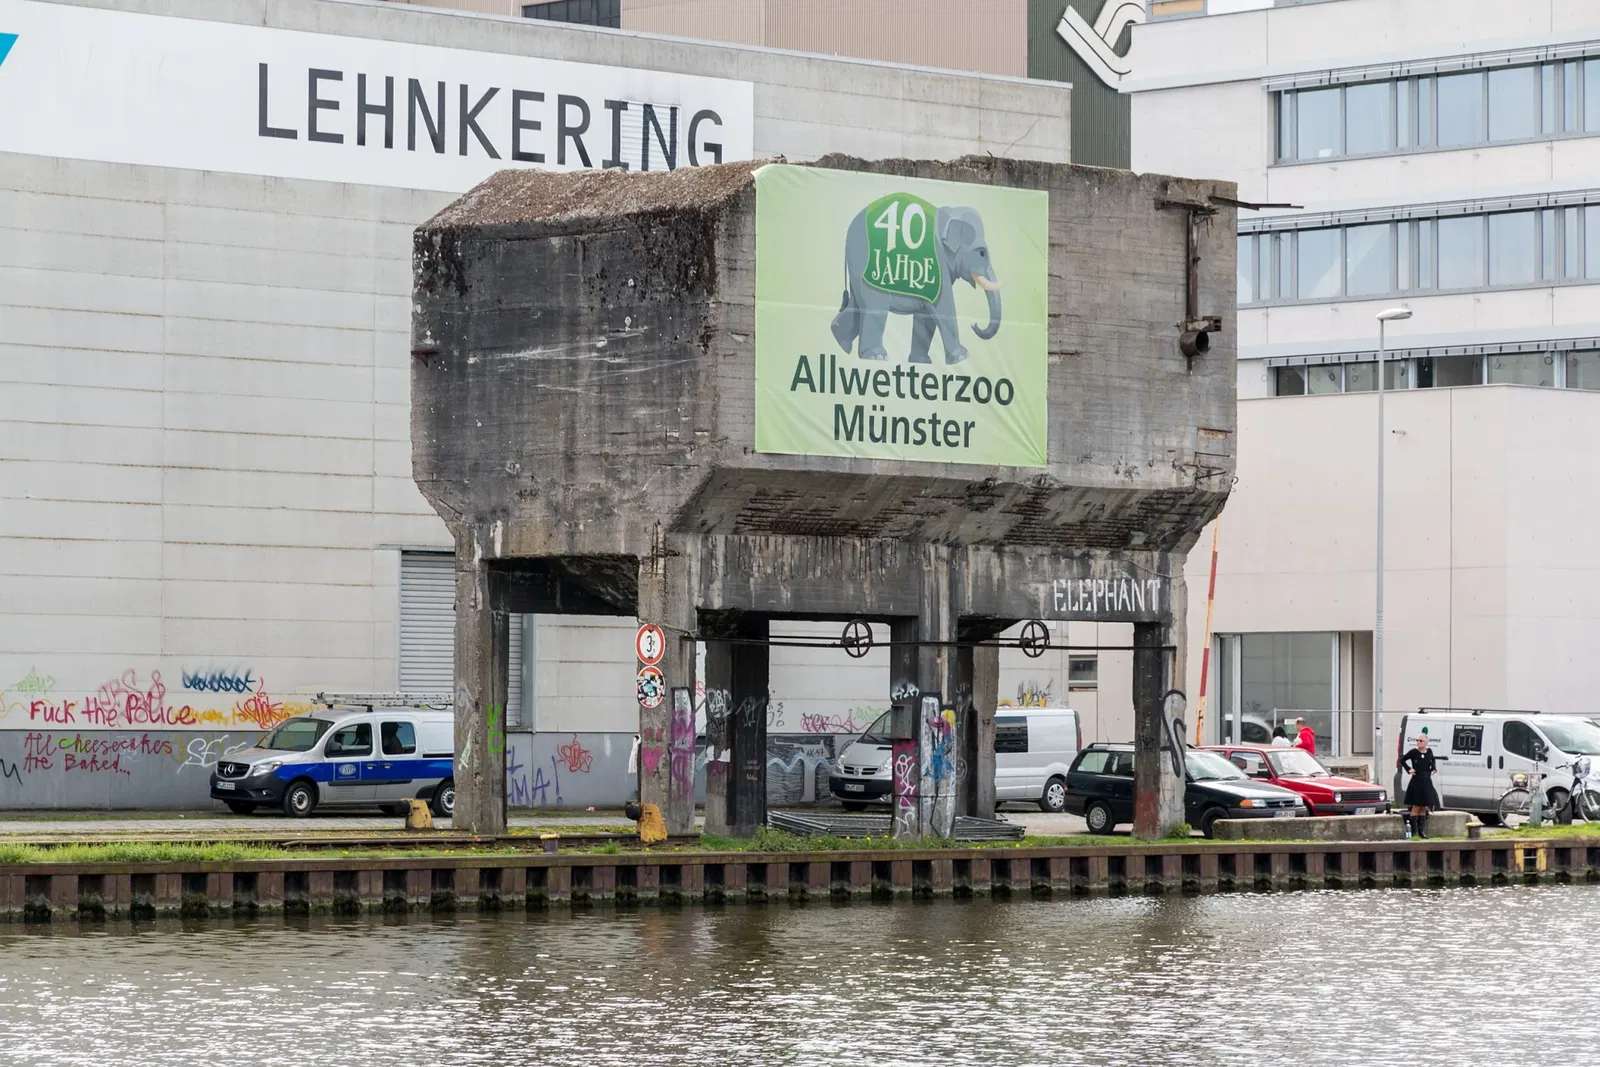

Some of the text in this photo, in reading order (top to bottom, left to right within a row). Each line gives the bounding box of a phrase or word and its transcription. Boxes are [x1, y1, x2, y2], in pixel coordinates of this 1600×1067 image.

[258, 62, 725, 172] LEHNKERING
[873, 200, 927, 253] 40
[871, 248, 936, 290] JAHRE
[790, 353, 1015, 406] Allwetterzoo
[833, 403, 976, 448] Münster
[1053, 578, 1162, 613] ELEPHANT
[29, 699, 76, 725] Fuck
[81, 696, 118, 728] the
[23, 753, 54, 774] Are
[24, 731, 58, 756] All
